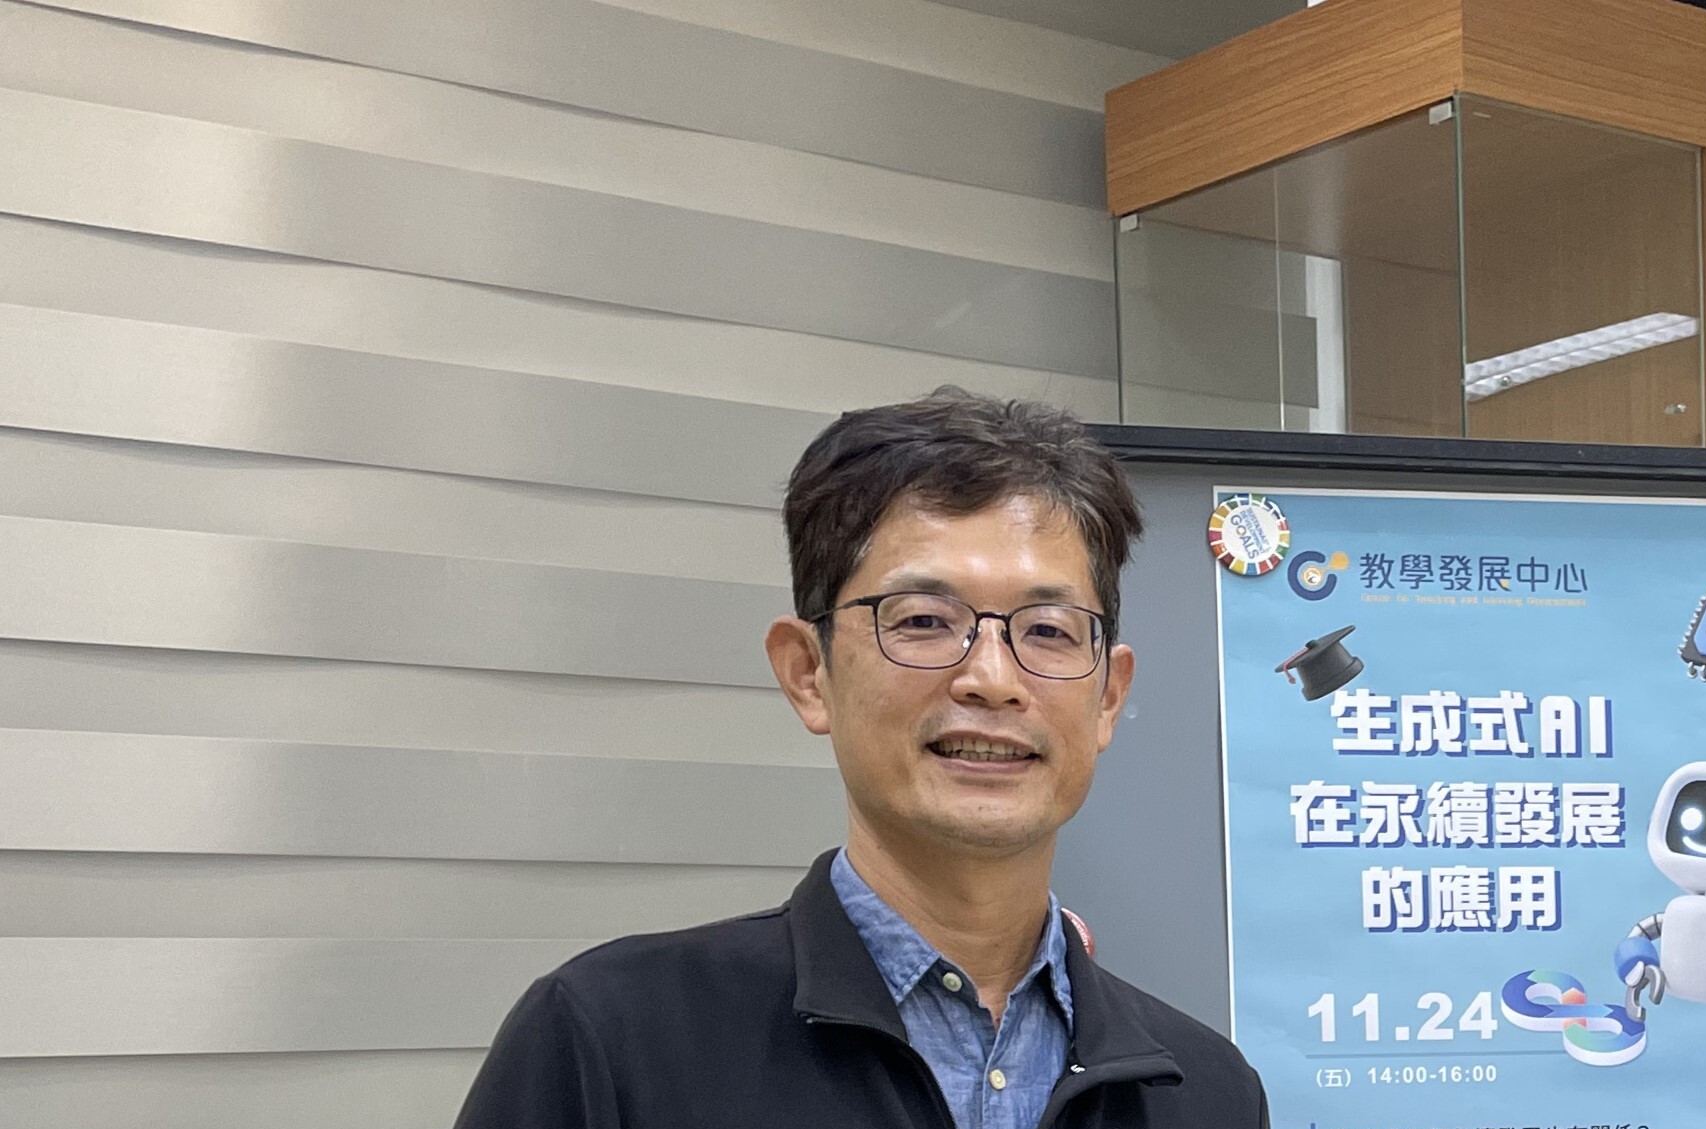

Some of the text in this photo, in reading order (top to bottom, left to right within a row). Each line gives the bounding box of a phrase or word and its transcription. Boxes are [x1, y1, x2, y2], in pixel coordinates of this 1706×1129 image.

[1229, 514, 1260, 559] GOALS
[1360, 552, 1589, 593] 教學發展中心
[1290, 780, 1626, 848] 在永續發展
[1362, 865, 1563, 933] 的應用
[1307, 991, 1499, 1042] 11.24
[1367, 1065, 1498, 1085] 14:00-16:00
